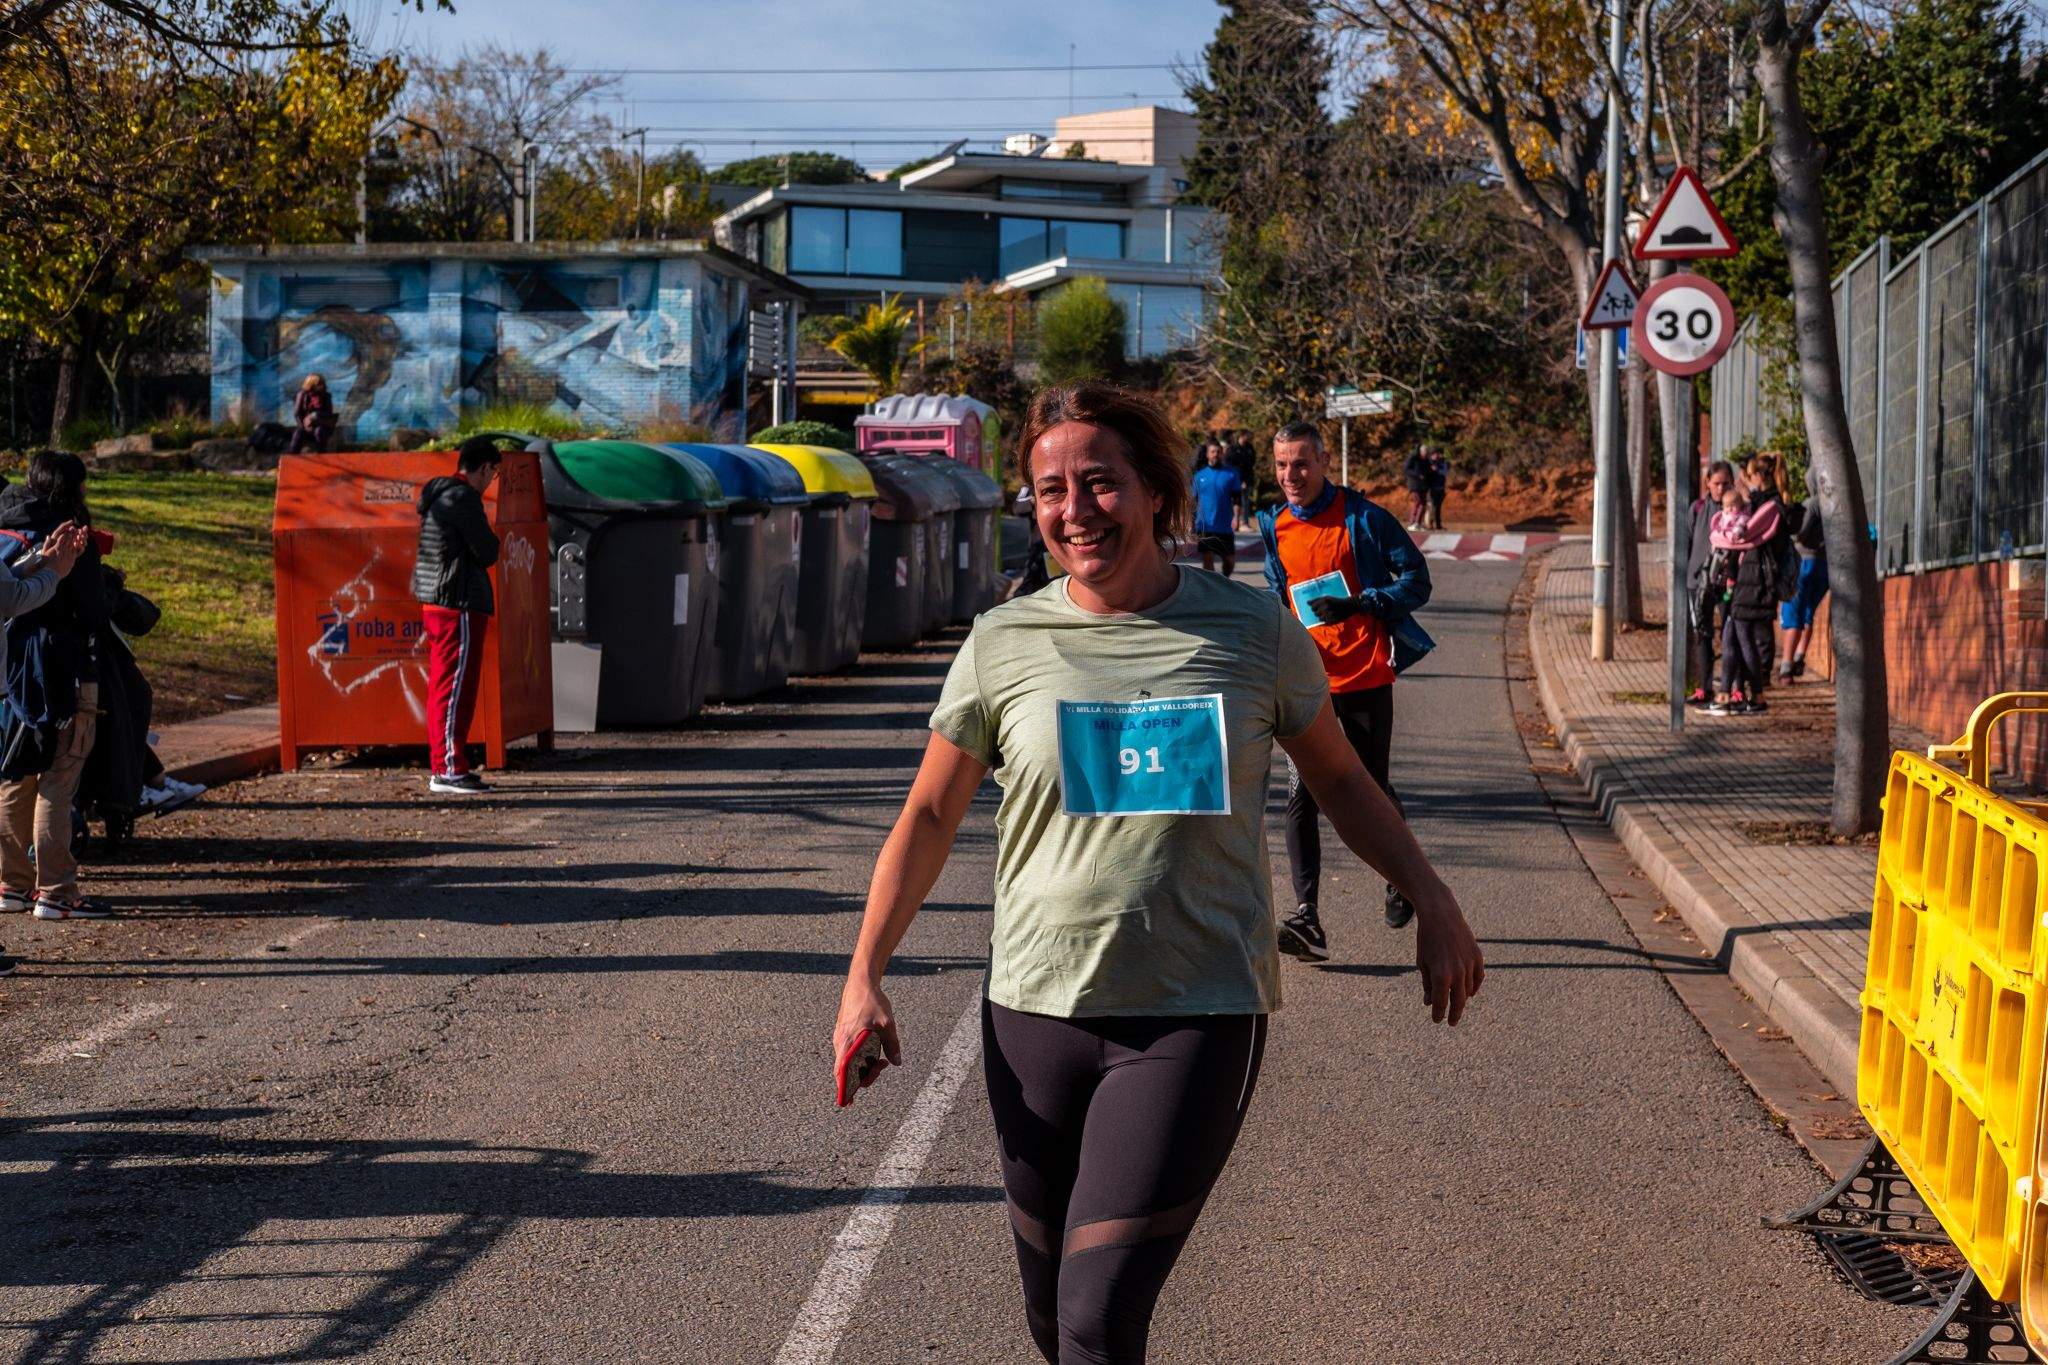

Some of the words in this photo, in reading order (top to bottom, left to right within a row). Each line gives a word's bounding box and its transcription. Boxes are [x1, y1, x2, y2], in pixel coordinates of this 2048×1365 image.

[1655, 308, 1713, 342] 30
[356, 617, 395, 638] roba
[1149, 704, 1160, 712] DE
[1162, 701, 1215, 711] VALLDOREIX
[1094, 719, 1136, 731] MILLA
[1142, 717, 1181, 730] OPEN
[1119, 746, 1165, 775] 91
